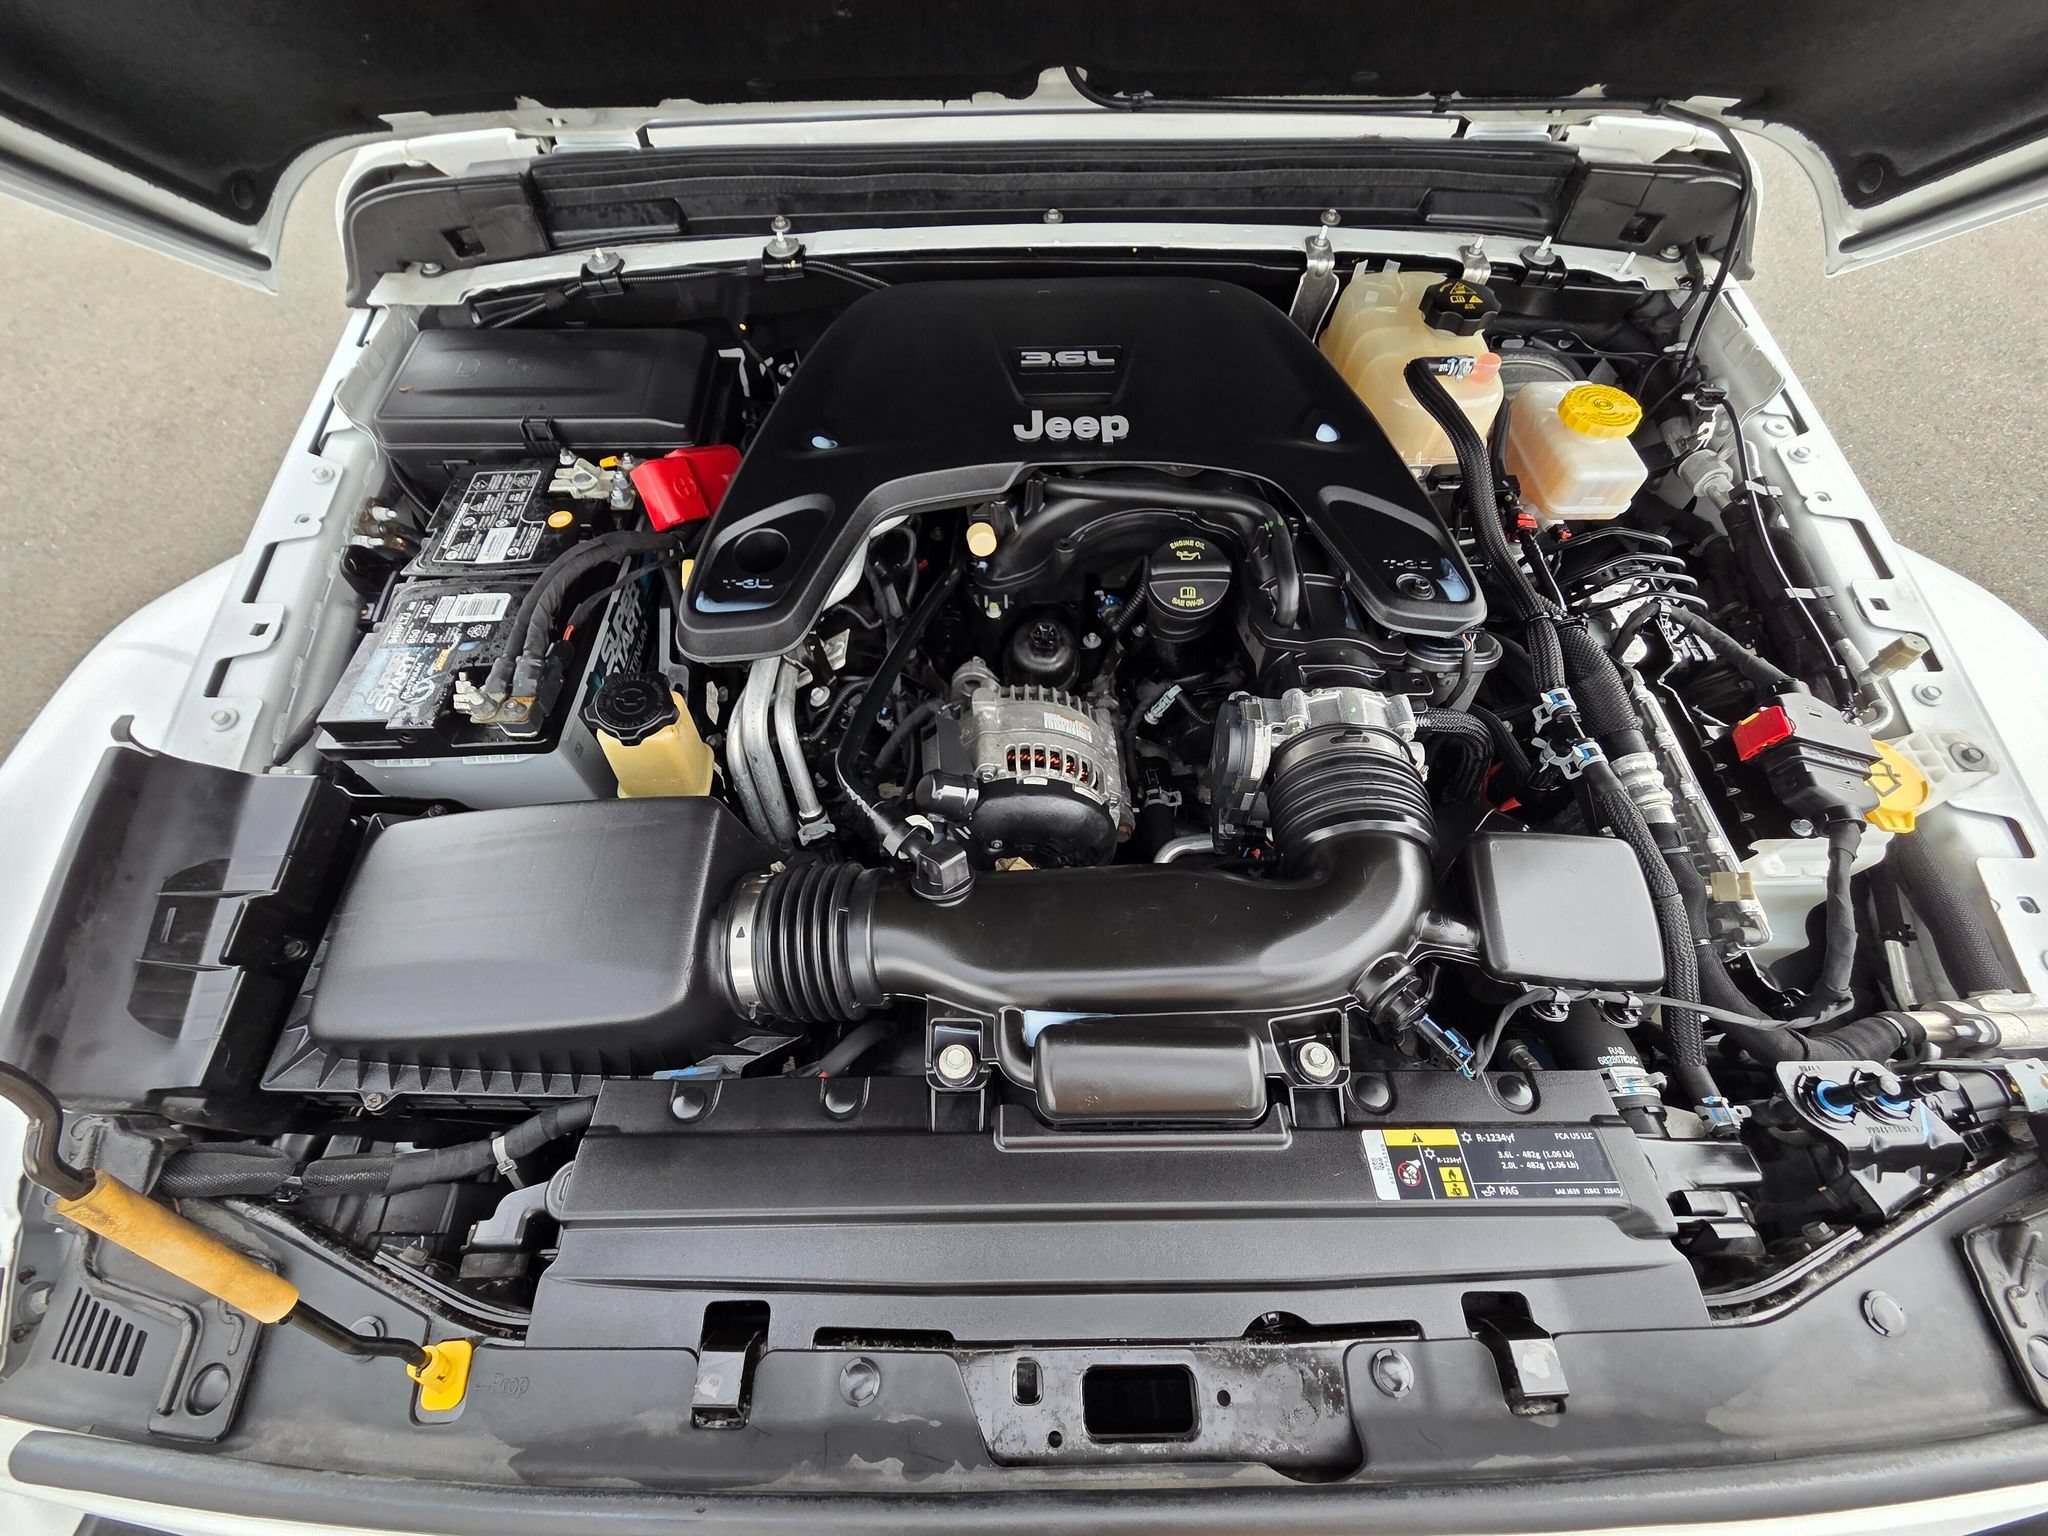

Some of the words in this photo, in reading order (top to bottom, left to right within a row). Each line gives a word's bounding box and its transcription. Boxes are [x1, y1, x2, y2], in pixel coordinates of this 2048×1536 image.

[1021, 351, 1115, 367] 3.6L
[1013, 410, 1129, 444] Jeep
[1169, 539, 1194, 549] ENGINE
[1195, 541, 1205, 550] OIL
[1171, 597, 1185, 606] SAE
[419, 604, 434, 618] 140
[601, 582, 640, 663] SUPER
[424, 632, 437, 644] 80
[629, 621, 648, 673] TINUM
[375, 654, 415, 713] START
[400, 662, 424, 699] PLATINUM
[1607, 1046, 1626, 1055] RAD
[1475, 1133, 1515, 1143] R-1234yf
[1554, 1132, 1569, 1140] FCA
[1570, 1132, 1580, 1140] US
[1581, 1132, 1594, 1140] LLC
[1436, 1156, 1462, 1164] R-1234yf
[1497, 1150, 1514, 1158] 3.6L
[1522, 1150, 1541, 1160] 482g
[1542, 1150, 1562, 1159] (1.06
[1562, 1150, 1574, 1159] Lb)
[1526, 1162, 1546, 1170] 482g
[1547, 1160, 1566, 1170] (1.06
[1566, 1160, 1580, 1170] Lb)
[1498, 1186, 1519, 1196] PAG
[490, 1373, 530, 1398] Prop
